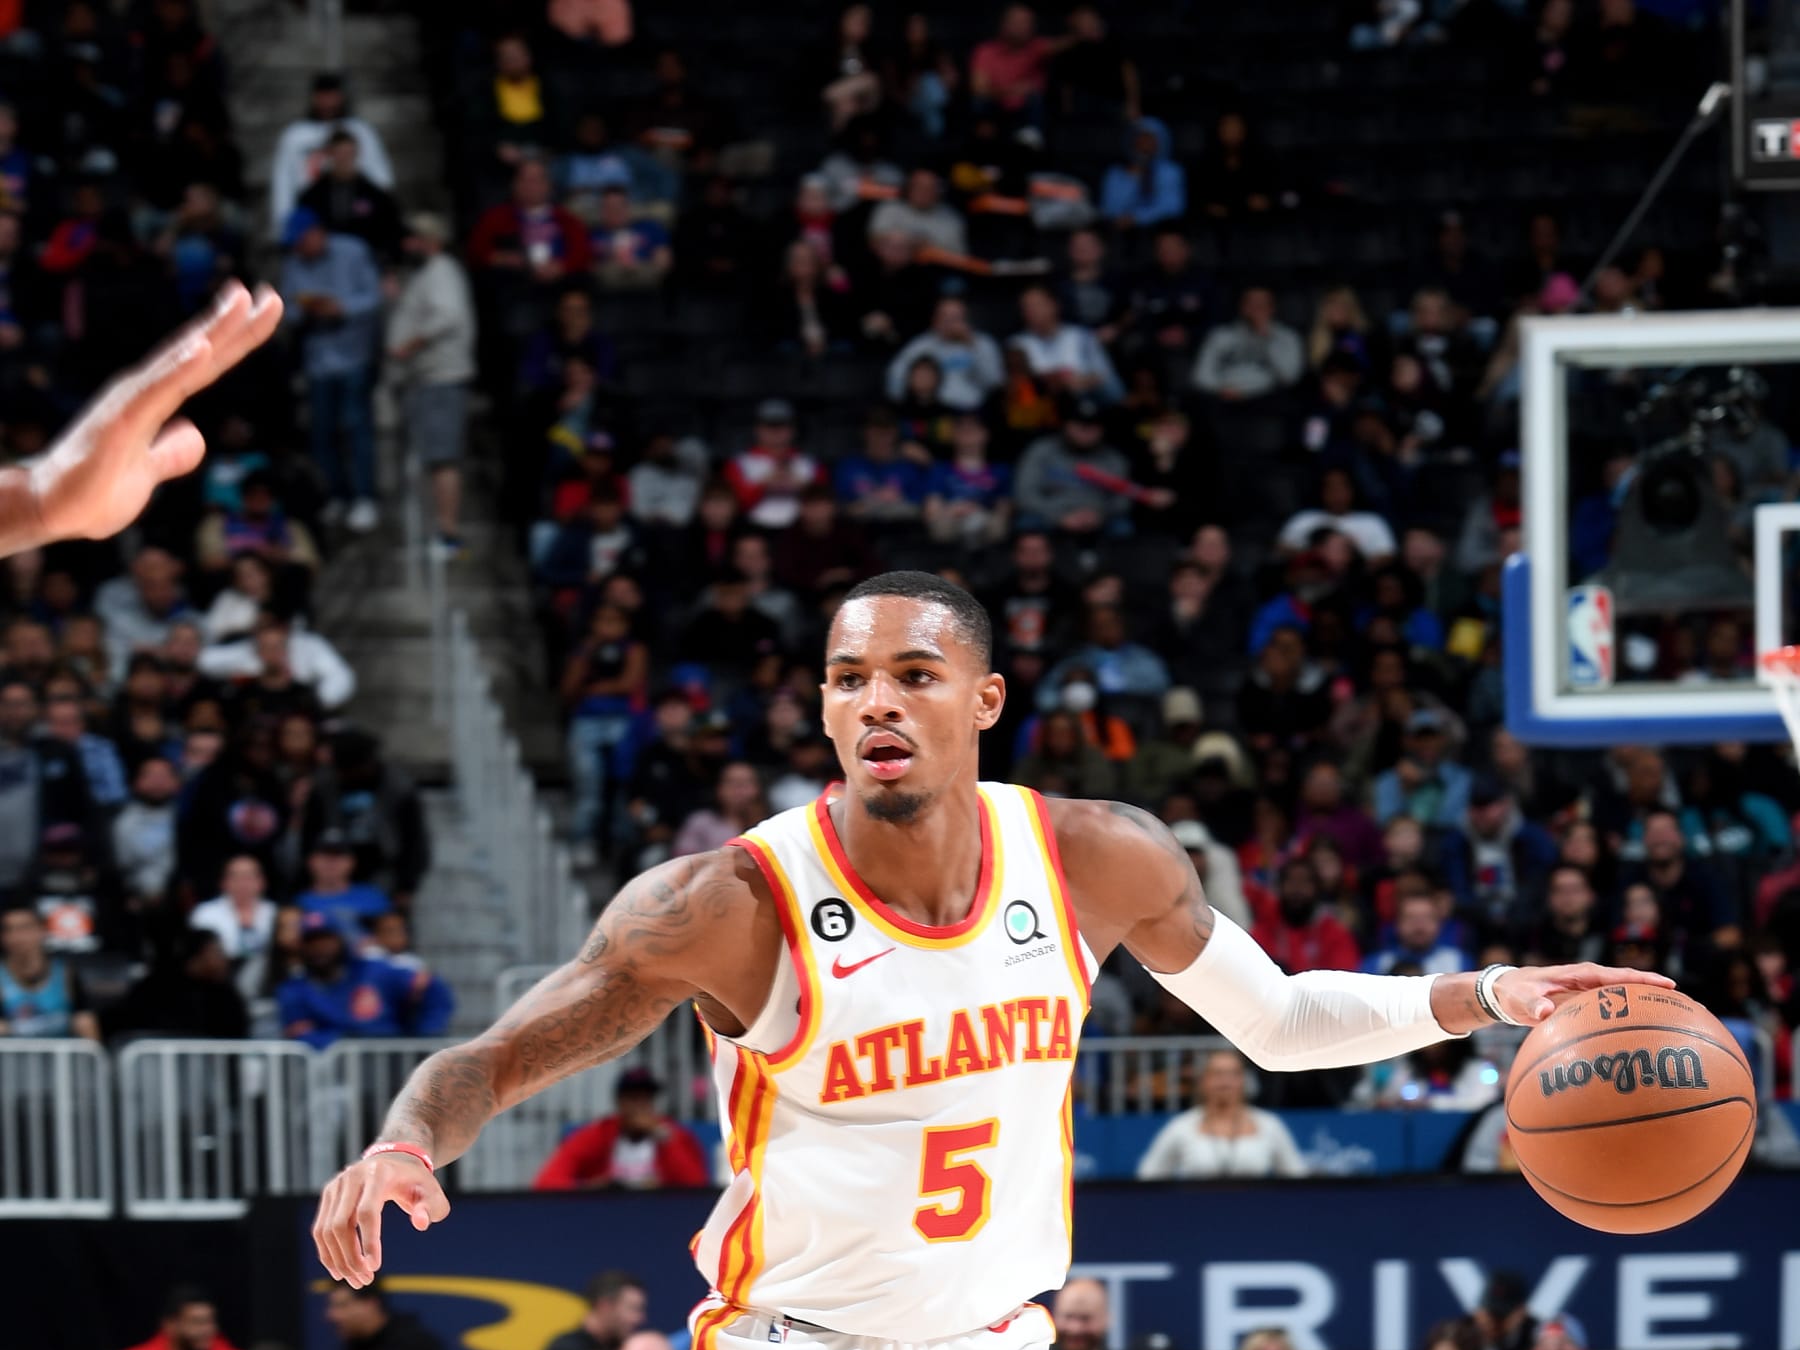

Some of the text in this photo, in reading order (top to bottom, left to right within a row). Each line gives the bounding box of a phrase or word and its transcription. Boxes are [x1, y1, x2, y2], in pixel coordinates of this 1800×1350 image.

[819, 904, 847, 938] 6
[1004, 943, 1057, 968] sharecare
[819, 997, 1075, 1105] ATLANTA
[1539, 1046, 1709, 1097] Wilson
[912, 1117, 1001, 1244] 5
